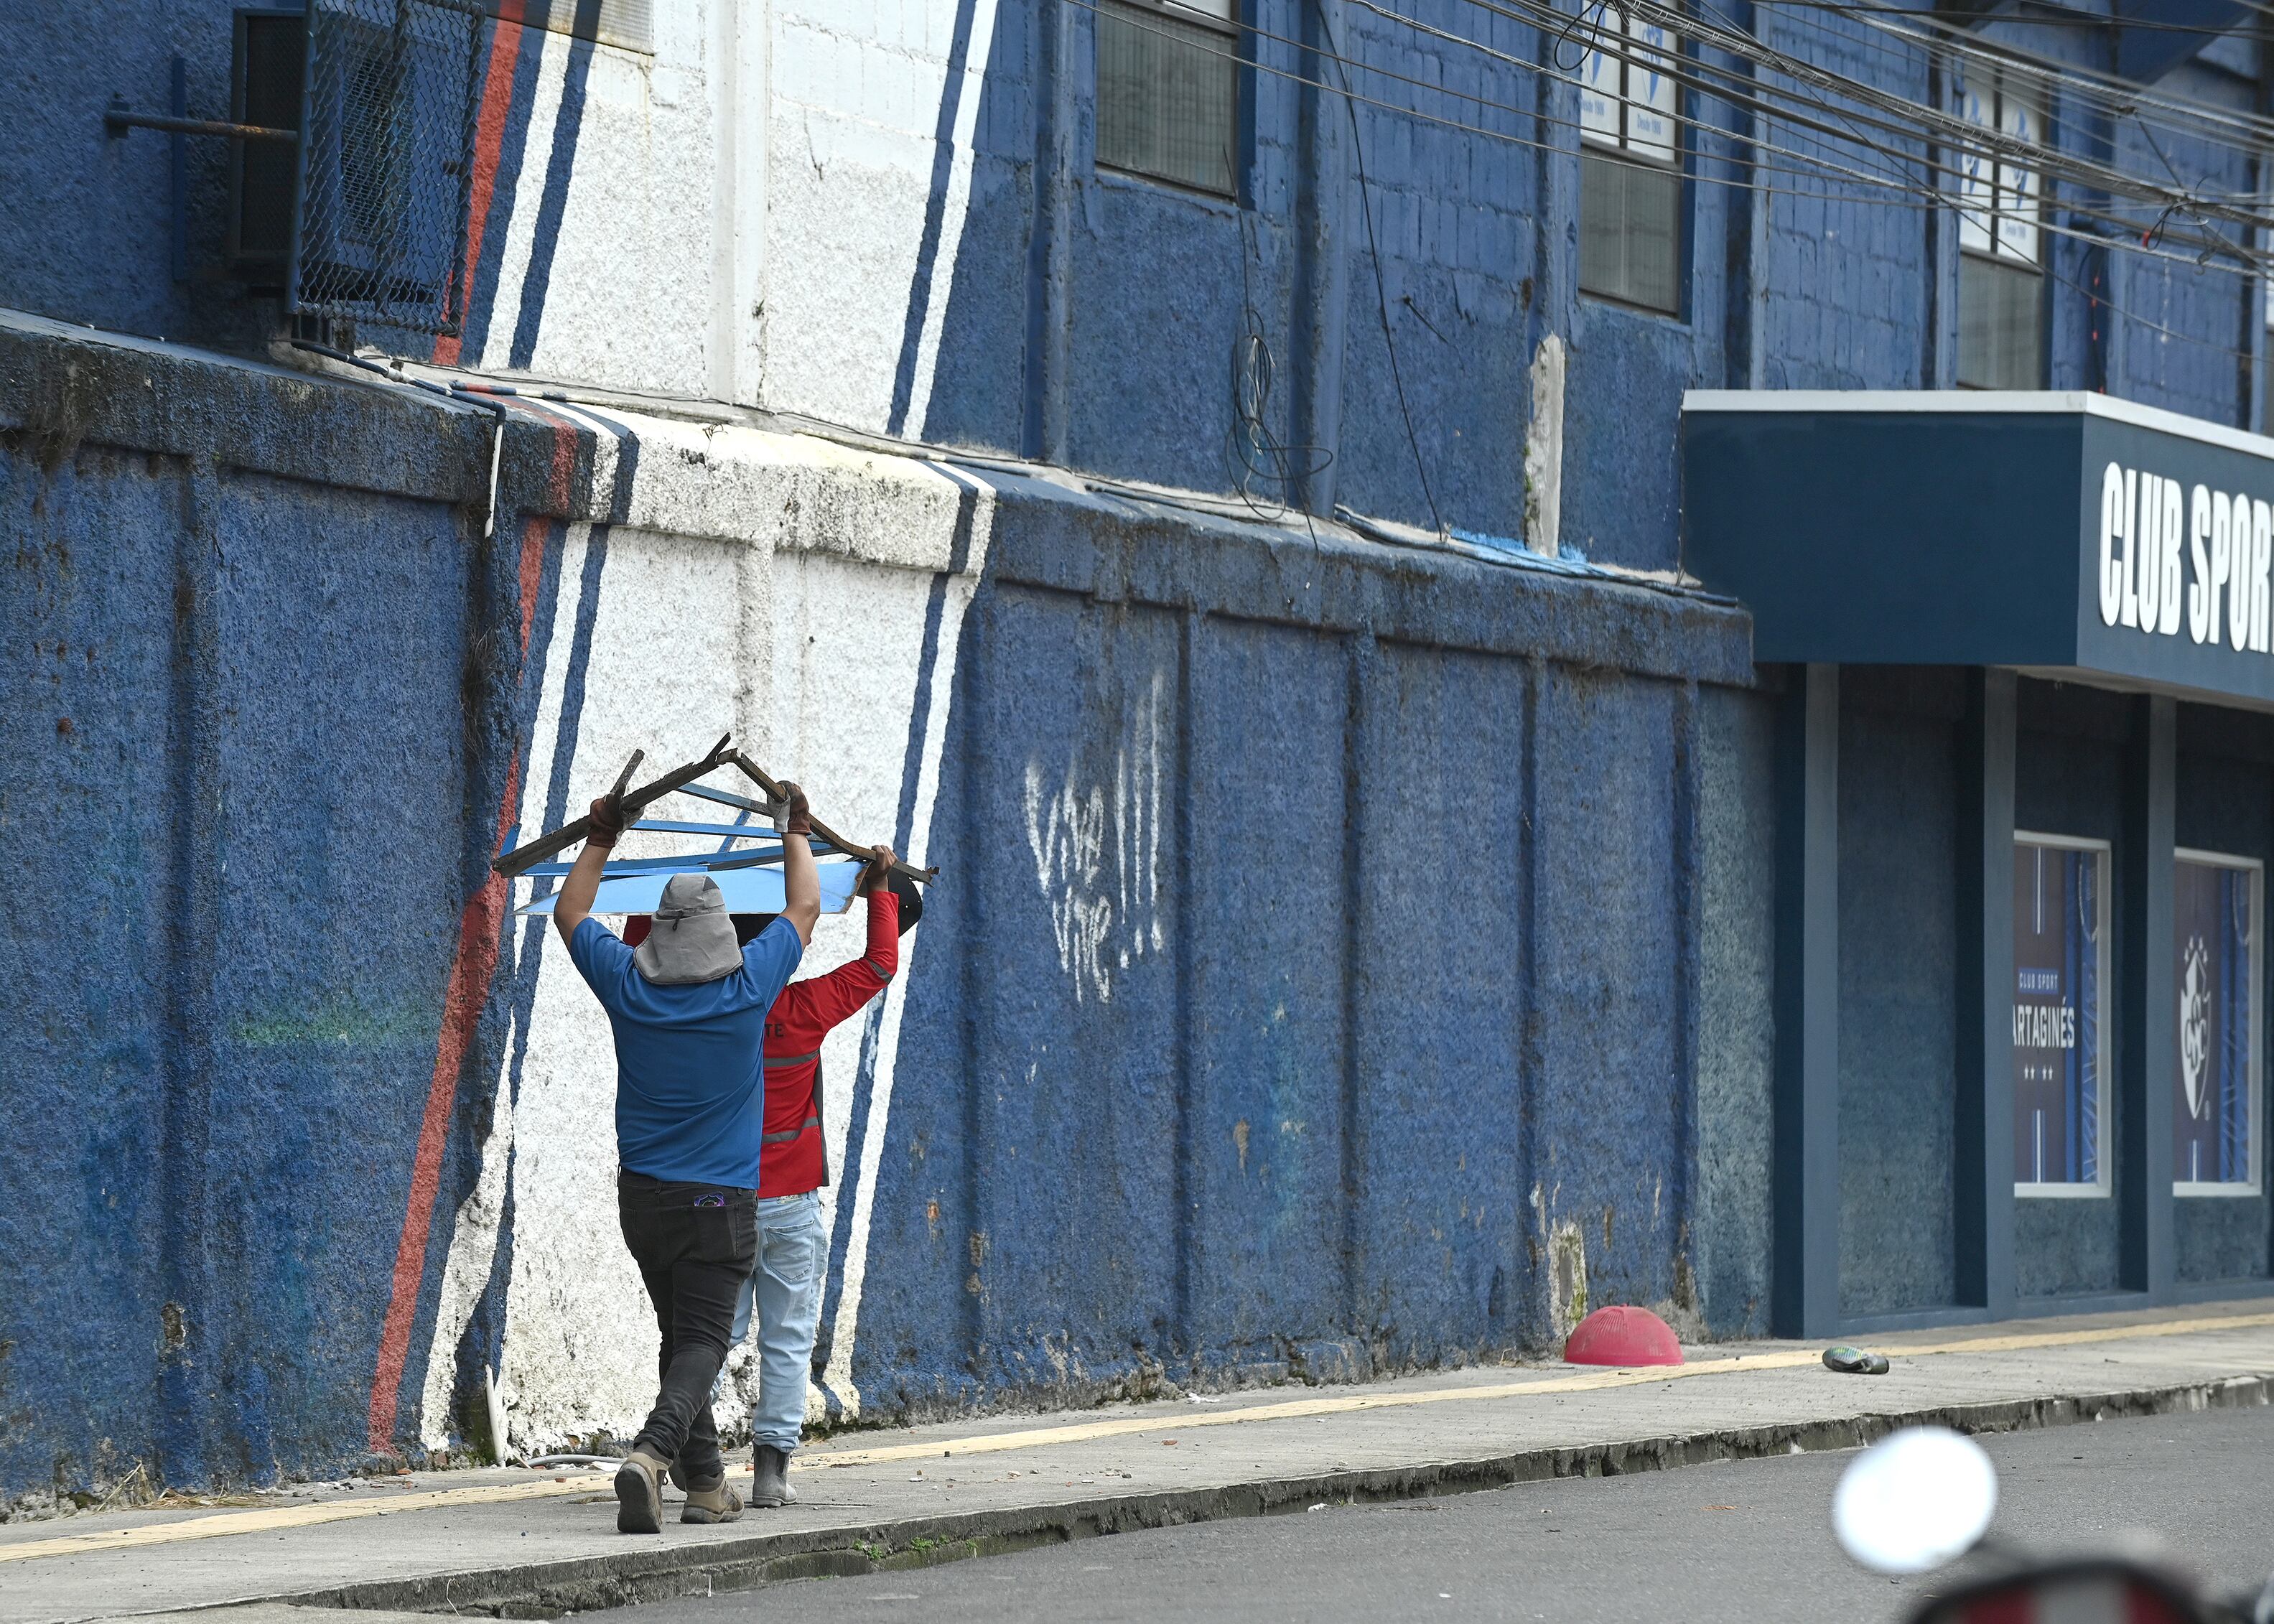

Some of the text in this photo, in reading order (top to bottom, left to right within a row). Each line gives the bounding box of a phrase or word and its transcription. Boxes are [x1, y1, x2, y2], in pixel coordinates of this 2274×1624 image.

[2099, 462, 2274, 654] CLUB SPOR
[2019, 972, 2058, 990] CLUB SPORT
